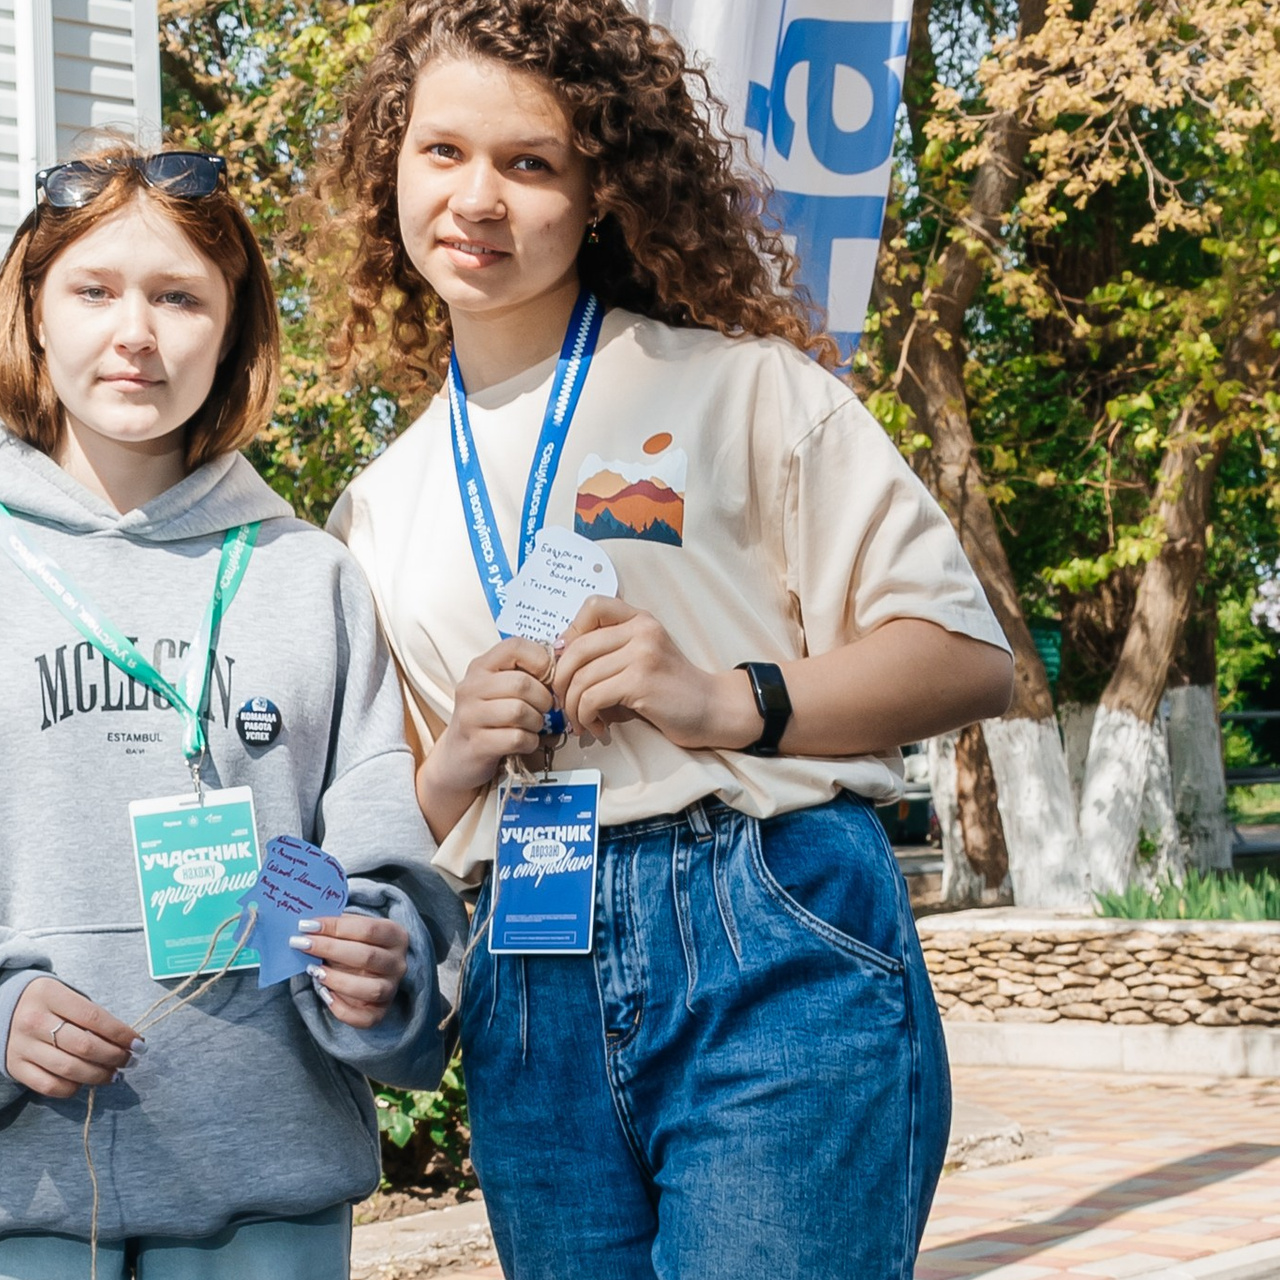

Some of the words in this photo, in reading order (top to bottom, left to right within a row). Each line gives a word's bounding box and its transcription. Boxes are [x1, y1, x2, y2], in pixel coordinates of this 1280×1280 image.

[529, 442, 555, 516] волнуйтесь
[470, 494, 495, 563] волнуйтесь
[240, 711, 277, 723] КОМАНДА
[244, 721, 272, 731] РАБОТА
[107, 732, 163, 742] ESTAMBUL
[245, 731, 270, 741] УСПЕХ
[501, 824, 591, 844] УЧАСТНИК
[141, 841, 253, 871] УЧАСТНИК
[530, 845, 560, 860] дерзаю
[182, 865, 216, 881] нахожу
[499, 865, 511, 880] и
[513, 846, 593, 888] открываю
[151, 870, 259, 921] призвание
